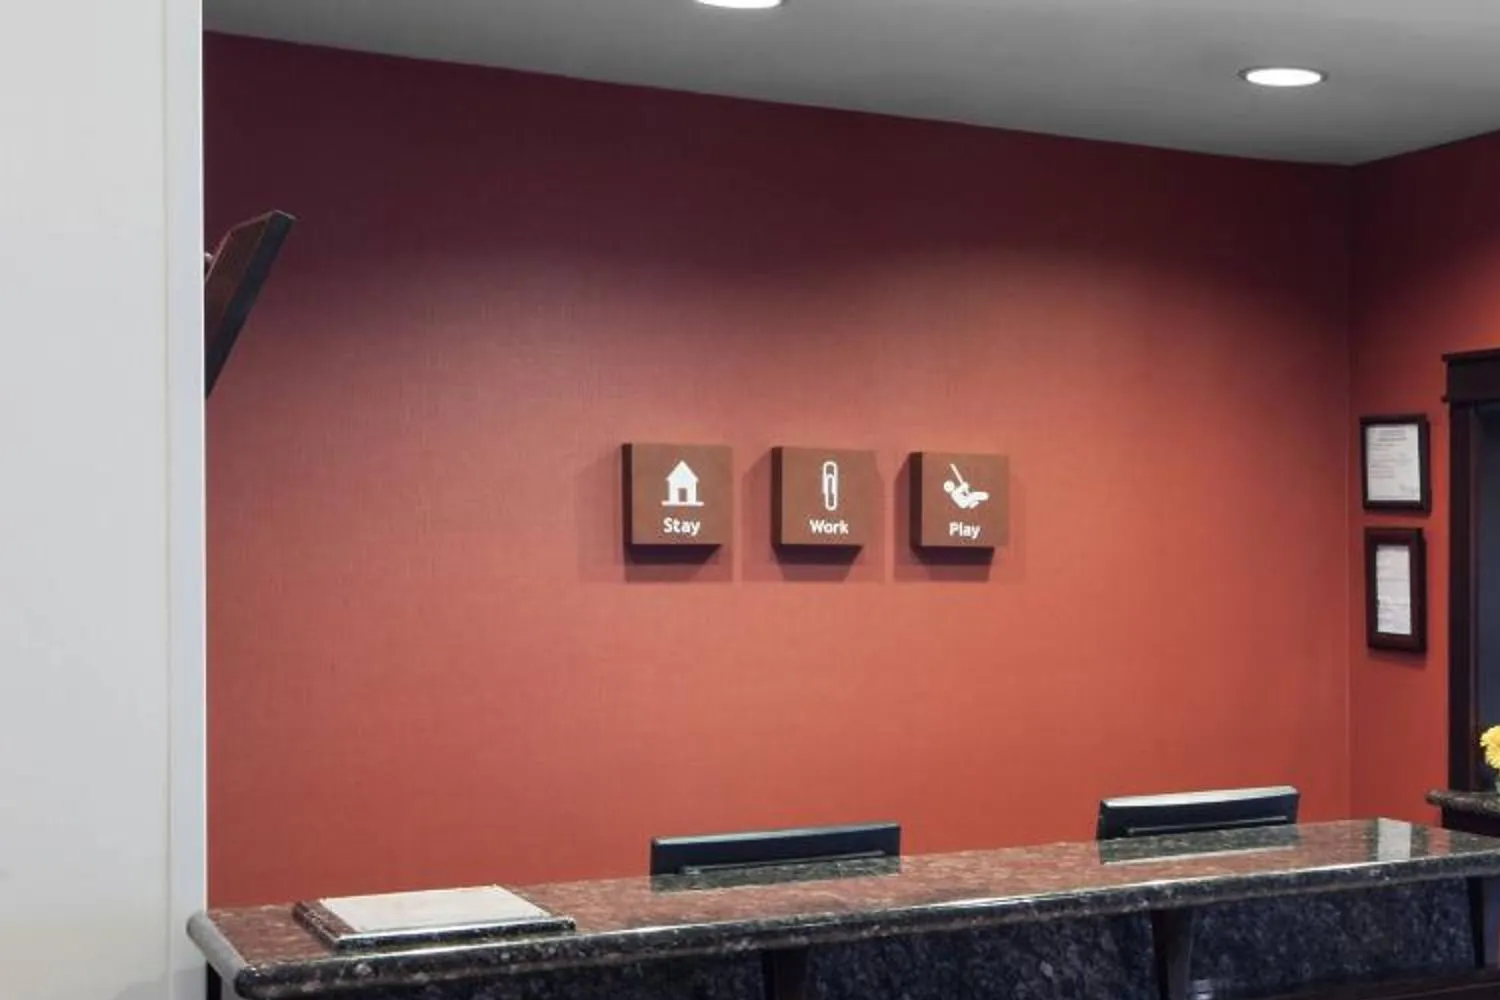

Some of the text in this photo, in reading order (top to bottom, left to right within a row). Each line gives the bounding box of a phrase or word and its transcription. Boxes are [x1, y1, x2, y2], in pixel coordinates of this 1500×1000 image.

[663, 517, 701, 536] Stay
[809, 519, 849, 535] Work
[949, 522, 981, 539] Play
